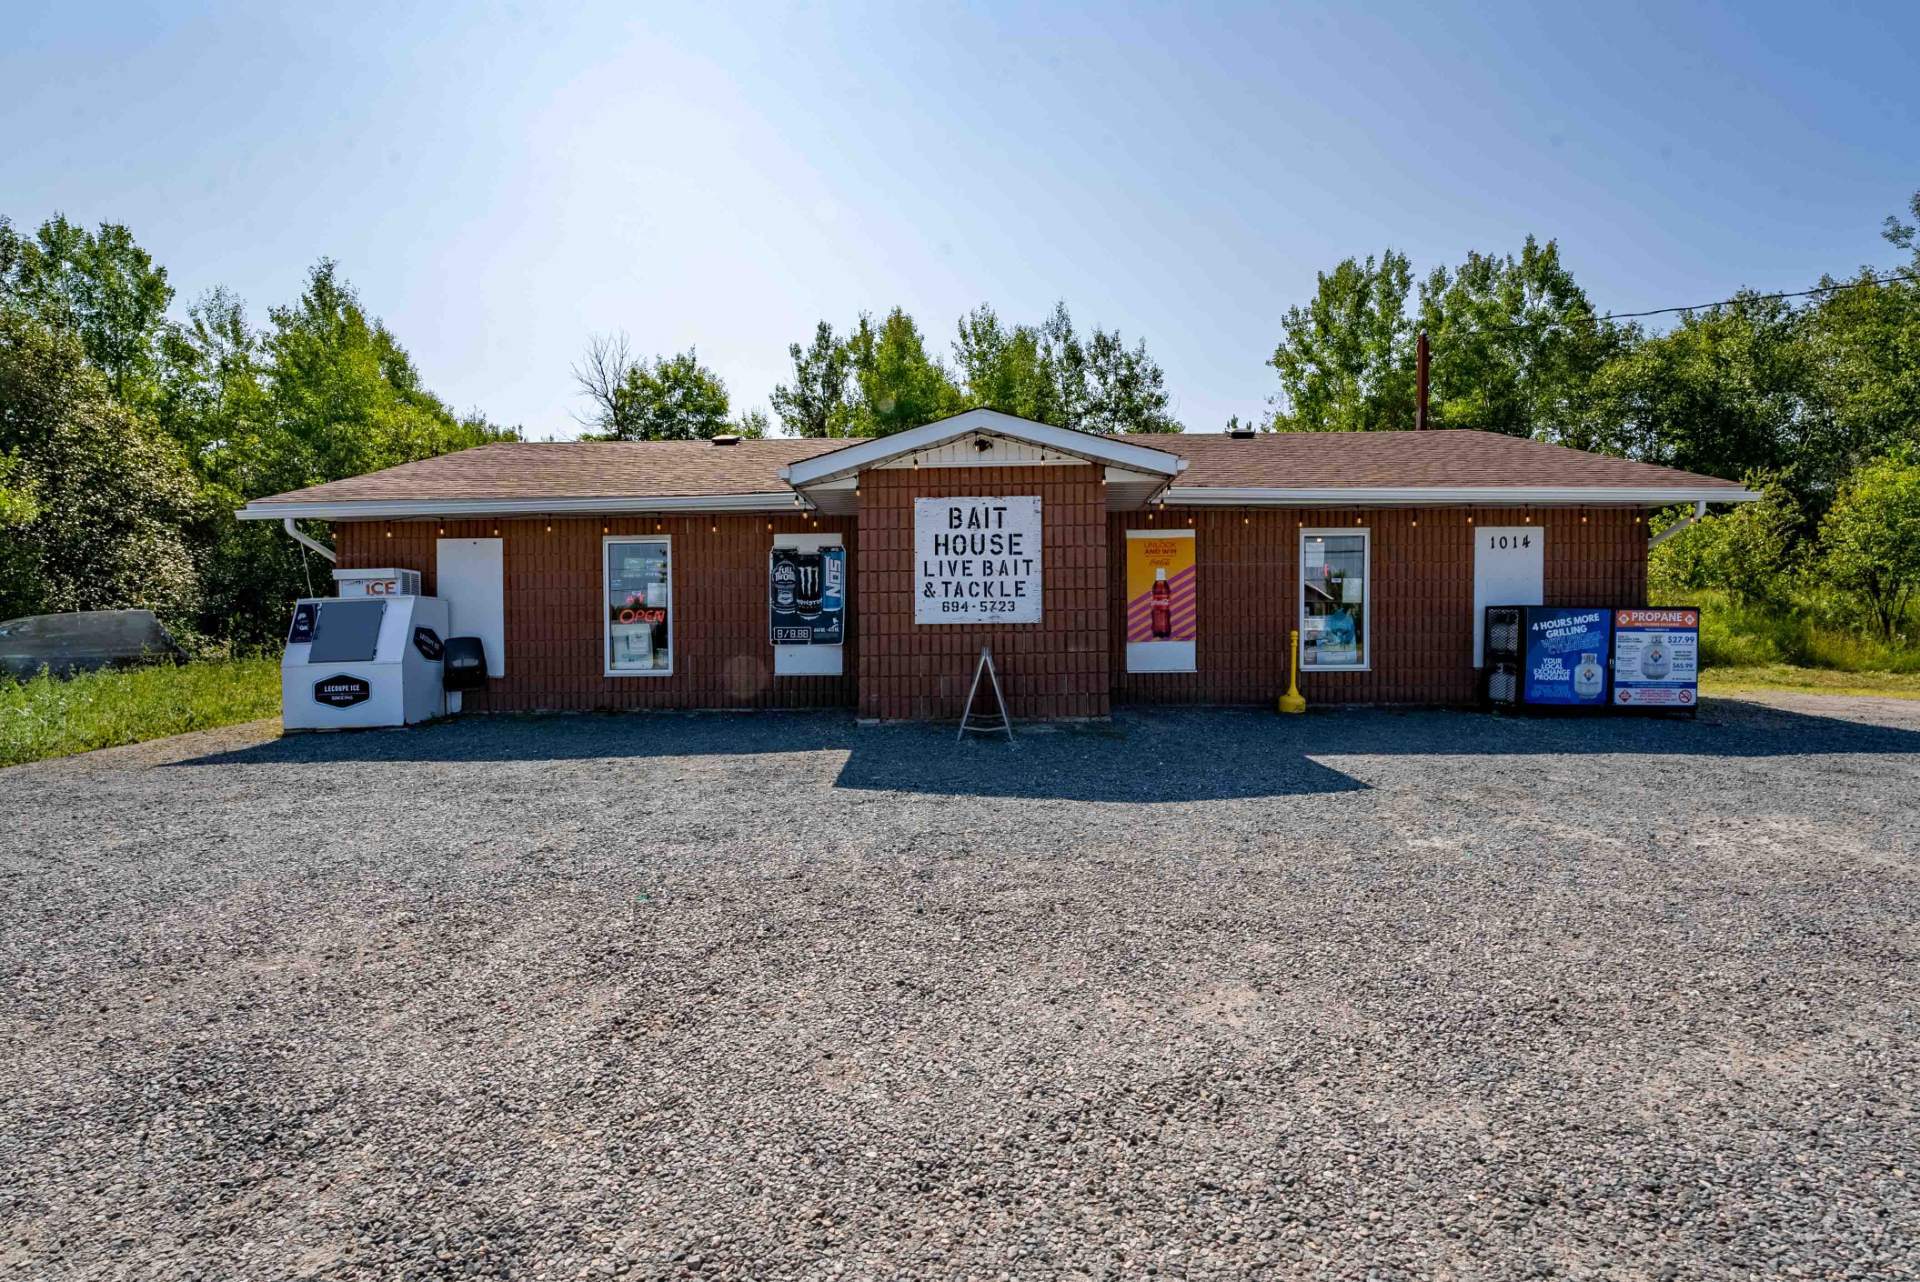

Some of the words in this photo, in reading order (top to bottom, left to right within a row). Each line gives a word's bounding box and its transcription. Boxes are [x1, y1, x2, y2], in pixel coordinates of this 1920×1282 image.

[949, 507, 1007, 529] BAIT
[934, 534, 1023, 556] HOUSE
[1490, 534, 1531, 549] 1014
[924, 560, 973, 577] LIVE
[983, 559, 1033, 576] BAIT
[825, 556, 841, 598] NOS
[366, 581, 397, 595] ICE
[924, 582, 936, 598] &
[941, 581, 1026, 598] TACKLE
[620, 609, 665, 624] OPEN
[1532, 622, 1539, 631] 4
[1540, 617, 1572, 630] HOURS
[1573, 613, 1600, 625] MORE
[1632, 612, 1682, 622] PROPANE
[1546, 625, 1587, 638] GRILLING
[1667, 635, 1695, 644] $27.99
